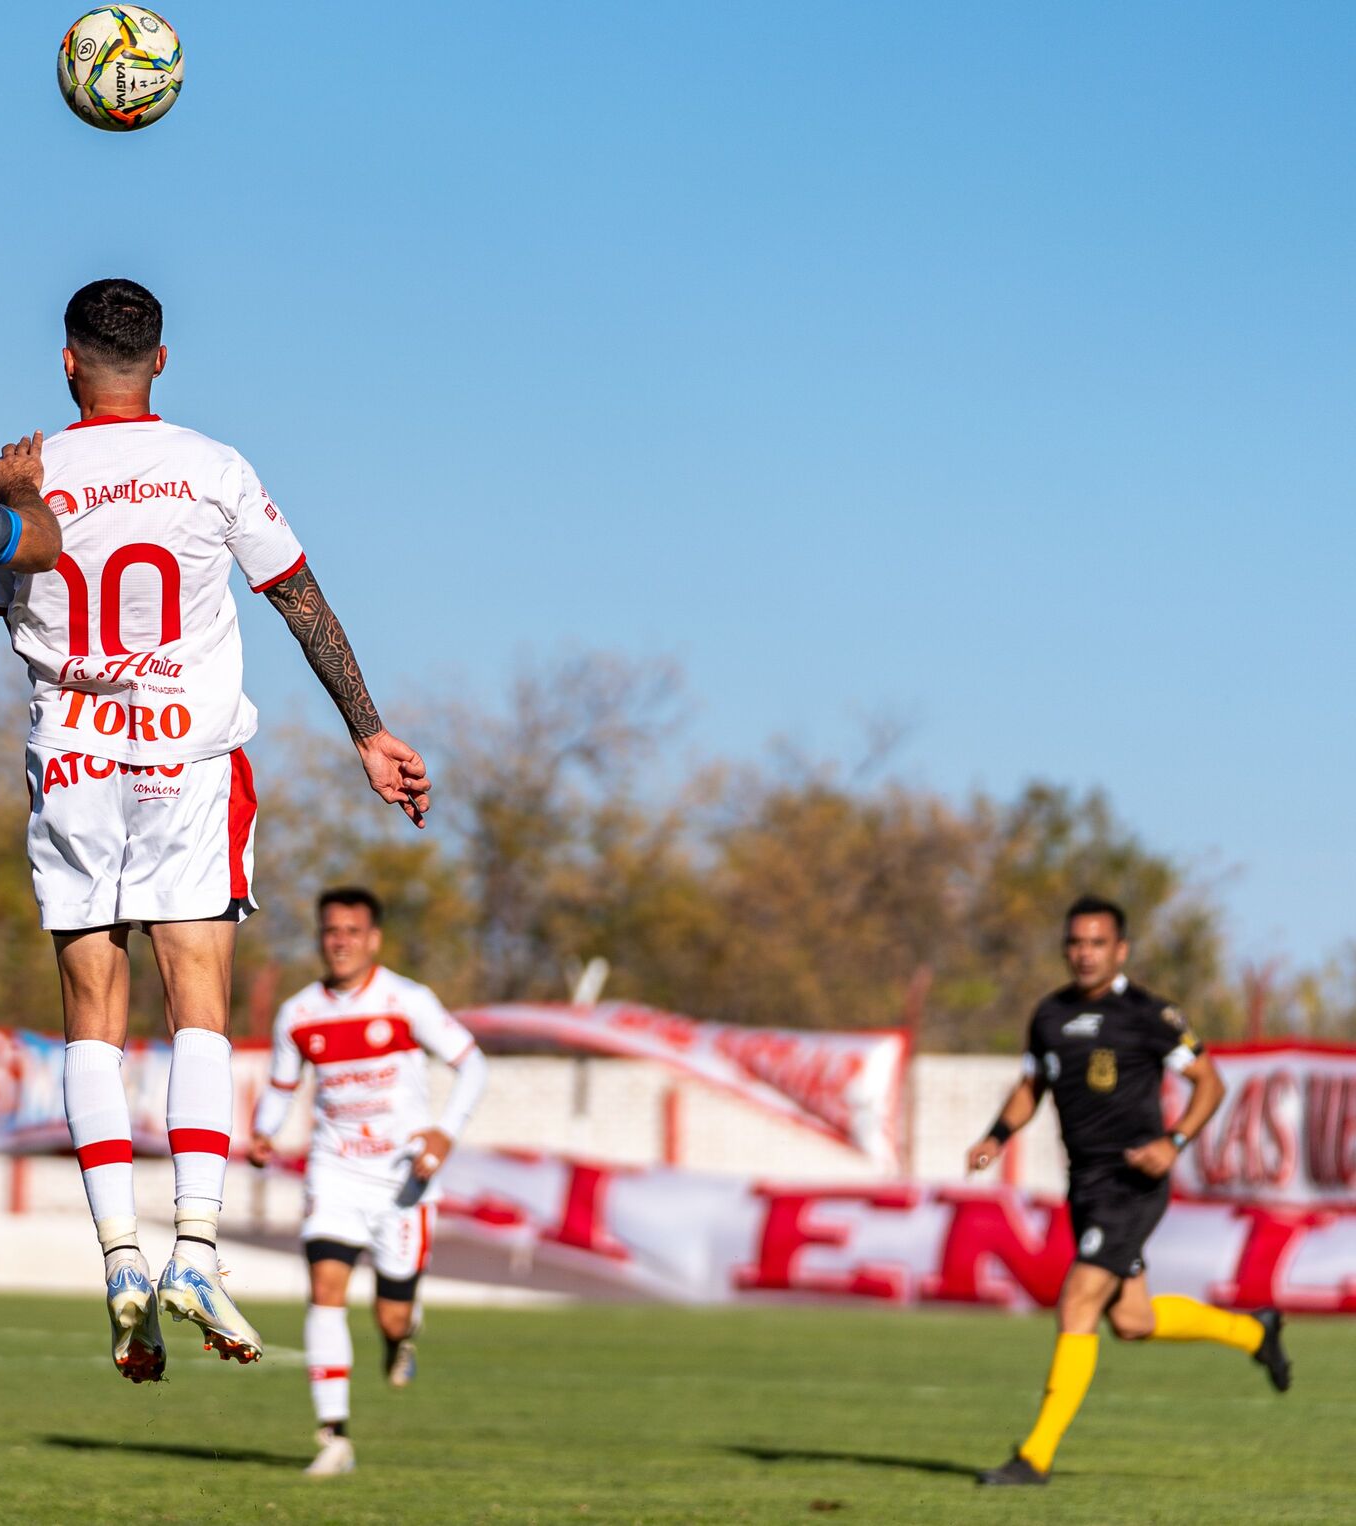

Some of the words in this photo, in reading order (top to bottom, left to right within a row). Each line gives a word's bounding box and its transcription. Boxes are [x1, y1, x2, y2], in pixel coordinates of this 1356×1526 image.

[116, 61, 127, 109] KAGIVA
[83, 479, 197, 510] BABILONIA
[95, 652, 183, 683] Anita
[58, 686, 192, 742] TORO
[133, 781, 181, 796] conviene
